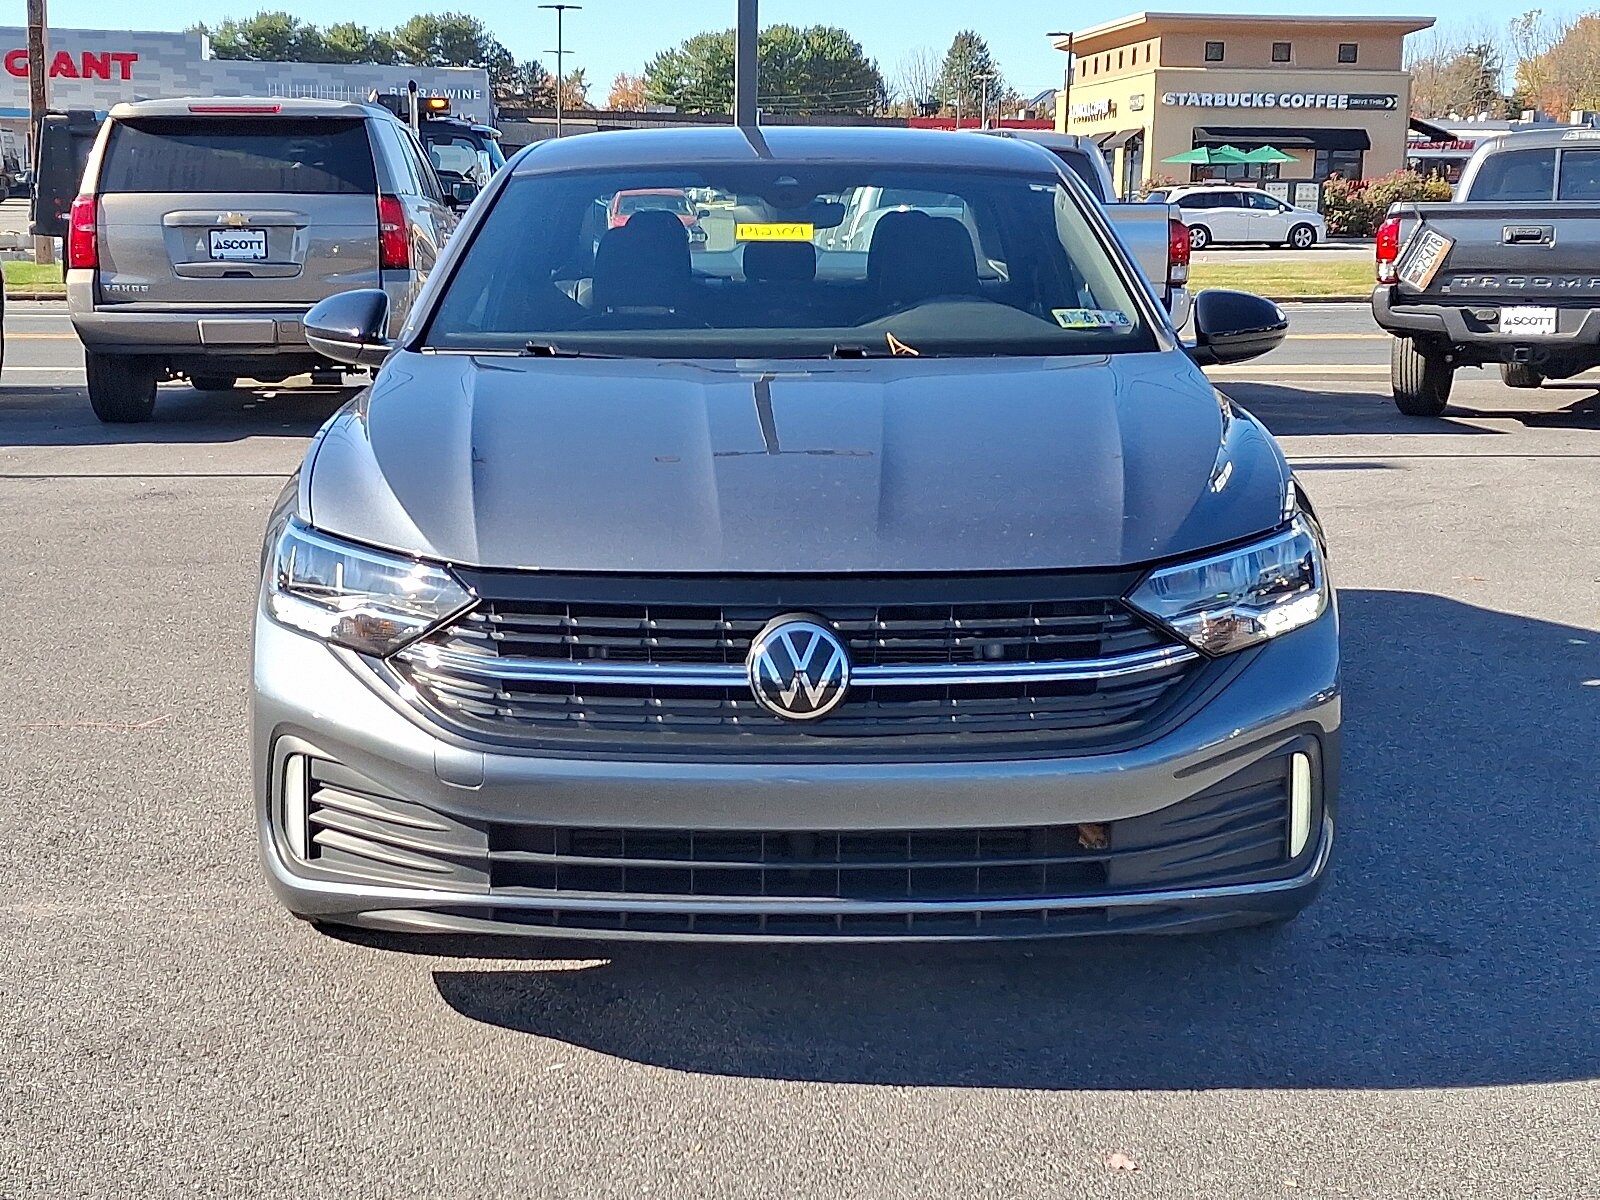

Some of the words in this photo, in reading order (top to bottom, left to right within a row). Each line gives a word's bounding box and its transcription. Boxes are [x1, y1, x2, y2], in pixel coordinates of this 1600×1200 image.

[4, 49, 138, 80] GANT
[389, 87, 427, 98] BER
[443, 88, 481, 99] WINE
[1163, 92, 1276, 108] STARBUCKS
[1278, 93, 1349, 110] COFFEE
[103, 284, 149, 292] TAHOE
